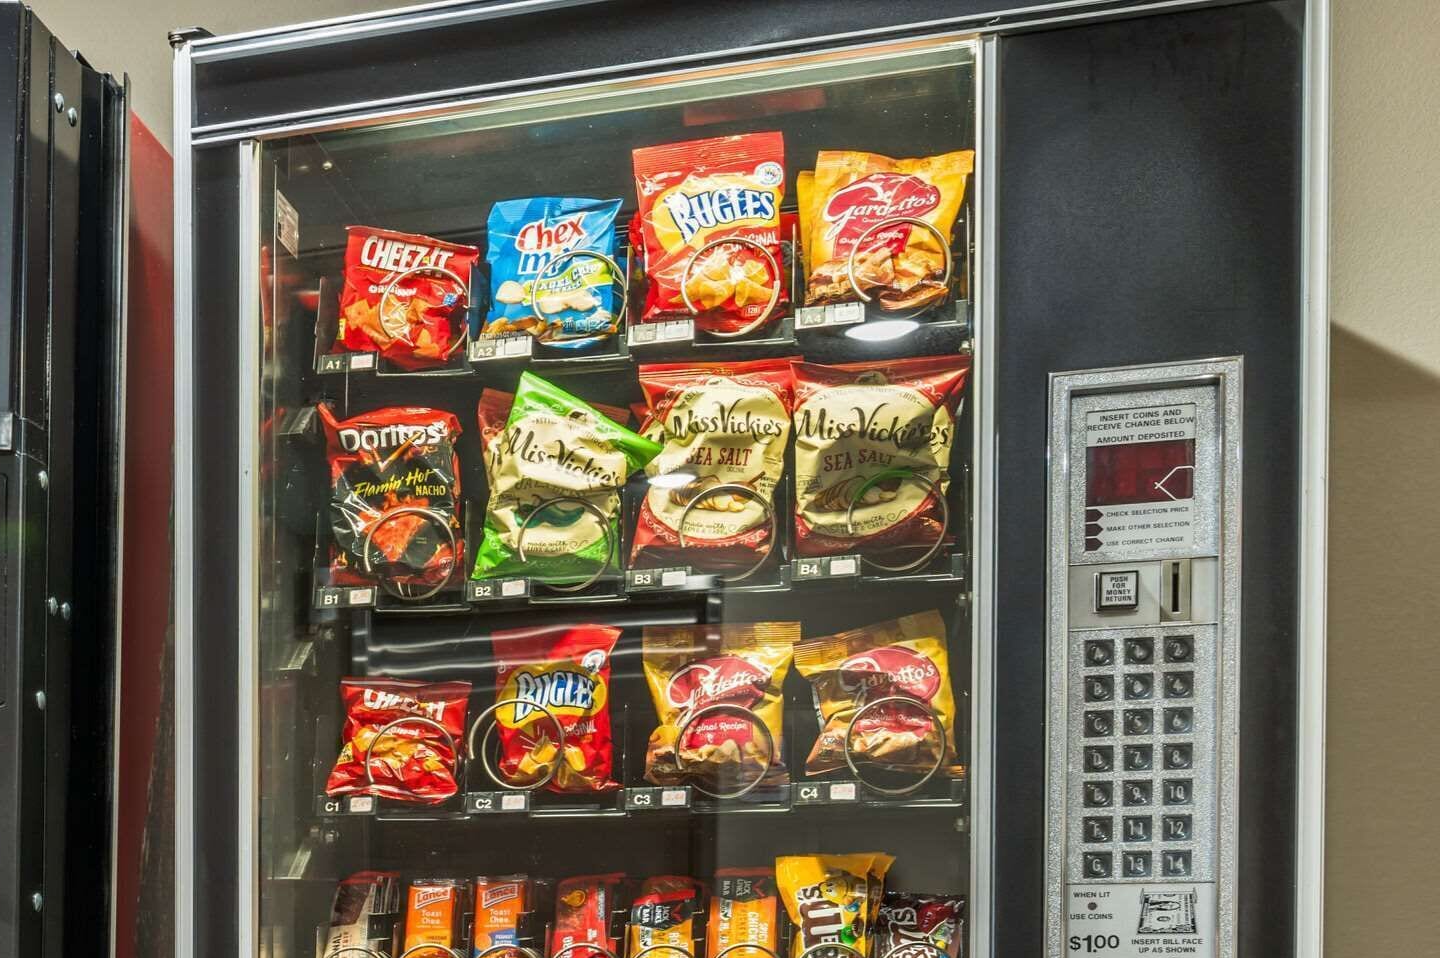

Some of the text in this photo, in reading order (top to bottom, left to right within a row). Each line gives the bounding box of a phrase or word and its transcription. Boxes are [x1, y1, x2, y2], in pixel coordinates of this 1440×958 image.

[664, 189, 775, 243] BUGLES
[517, 215, 586, 250] Chex
[361, 235, 454, 276] CHEEZ-IT
[806, 314, 822, 324] A4
[478, 347, 493, 357] A2
[326, 360, 340, 370] A1
[1100, 408, 1182, 422] INSERT COINS AND
[712, 398, 783, 445] Vickie's
[797, 408, 857, 441] Miss
[1087, 416, 1194, 431] RECEIVE CHANGE BELOW
[338, 420, 448, 451] Doritos
[1096, 431, 1185, 444] AMOUNT DEPOSITED
[686, 448, 752, 466] SEA SALT
[824, 449, 896, 472] SEA SALT
[354, 468, 435, 498] Flamin' Hot
[416, 485, 446, 496] NACHO
[1131, 507, 1168, 516] SELECTION
[1128, 523, 1151, 531] OTHER
[1152, 521, 1190, 529] SELECTION
[1155, 535, 1184, 543] CHANGE
[800, 564, 818, 575] B4
[635, 574, 651, 584] B3
[475, 585, 491, 596] B2
[1106, 588, 1131, 596] MONEY
[325, 595, 338, 604] B1
[1093, 680, 1182, 694] B 4
[514, 672, 595, 723] BUGLES
[1173, 715, 1182, 727] 6
[1172, 751, 1181, 763] 8
[801, 788, 818, 799] C4
[1170, 785, 1185, 799] 10
[476, 800, 492, 809] C2
[634, 795, 650, 805] C3
[325, 802, 340, 811] C1
[1129, 820, 1184, 834] 11 12
[417, 889, 449, 902] Lance
[1069, 935, 1120, 953] $1.00
